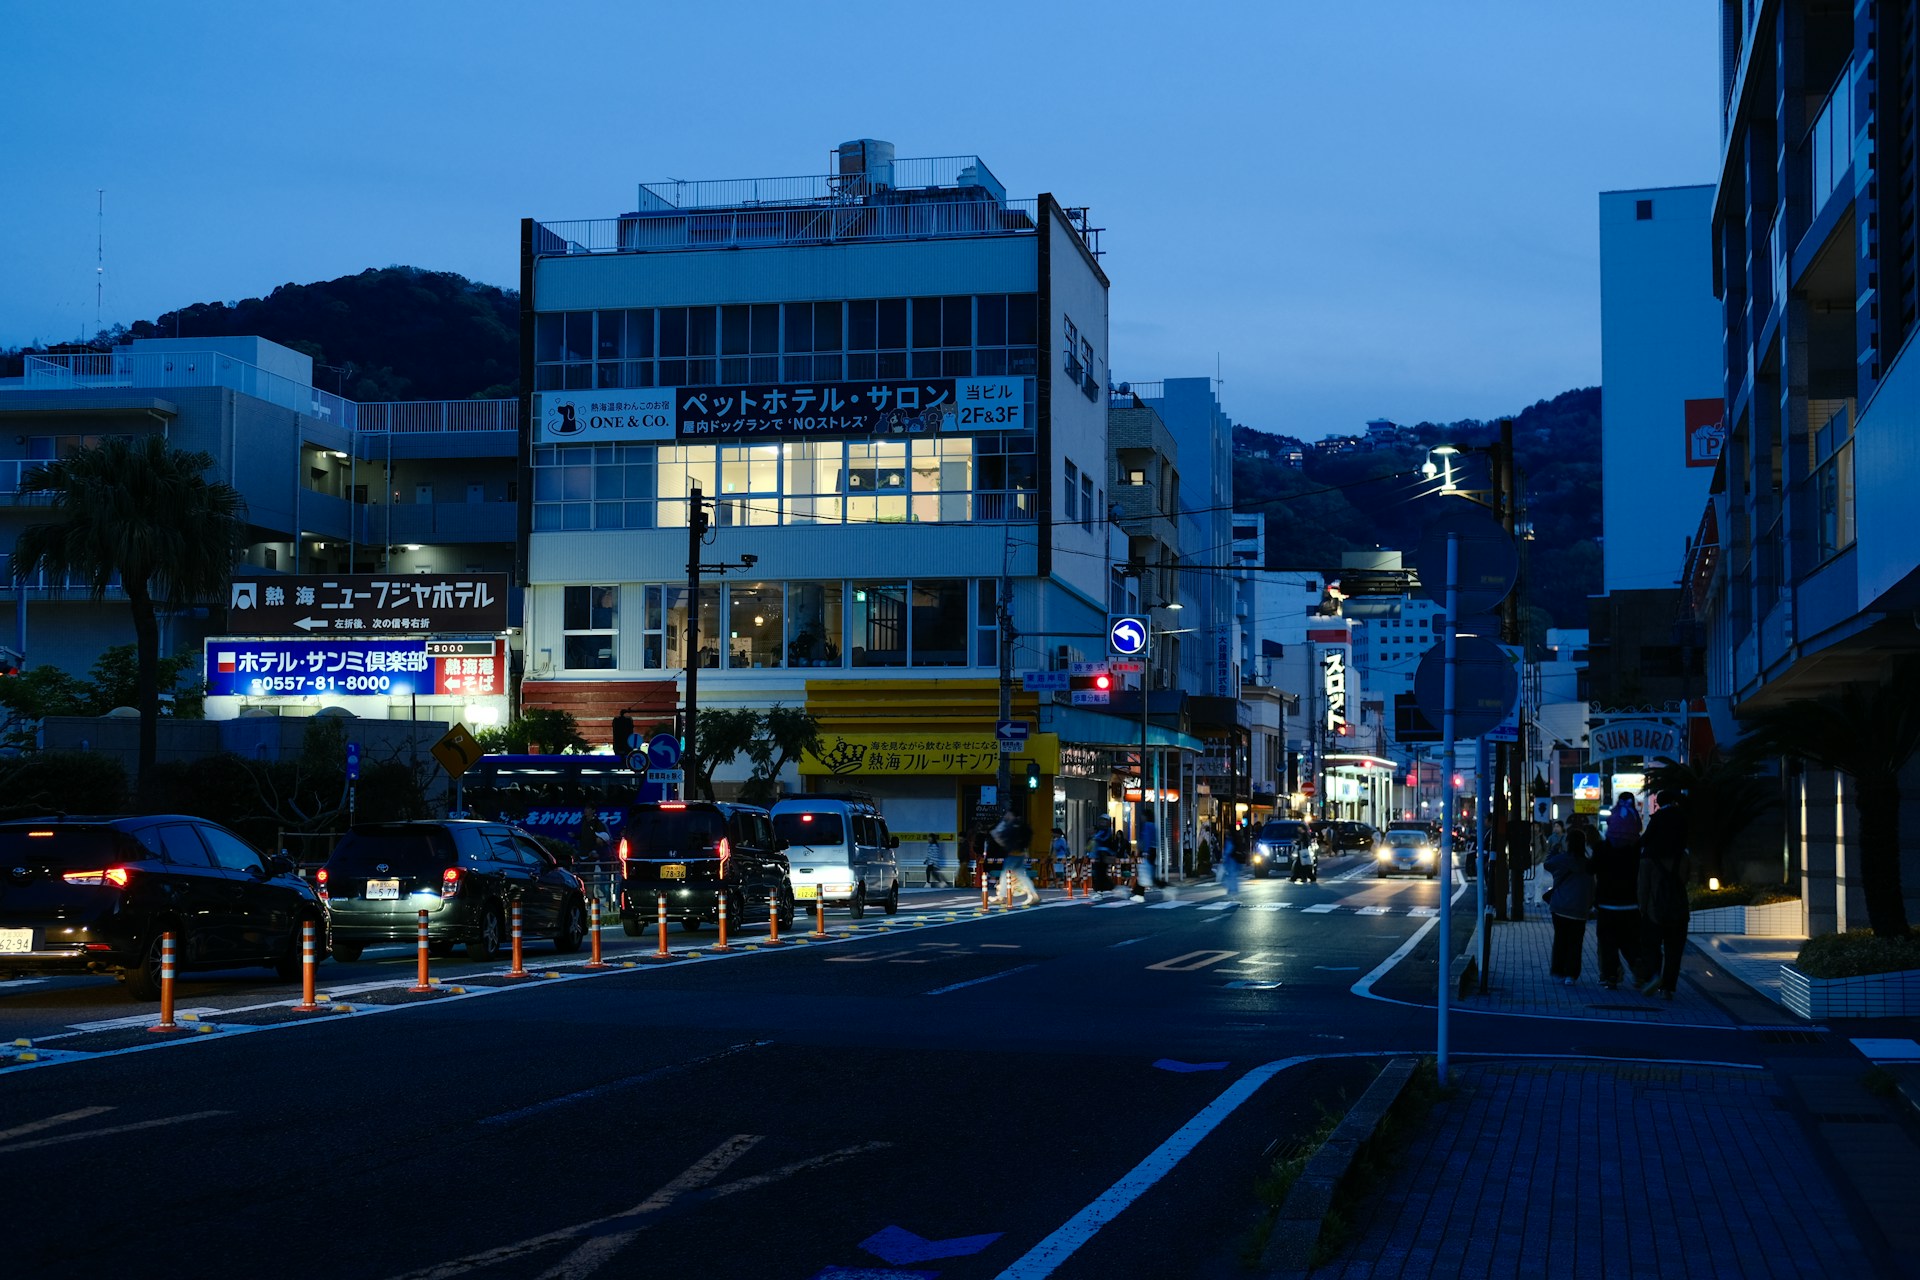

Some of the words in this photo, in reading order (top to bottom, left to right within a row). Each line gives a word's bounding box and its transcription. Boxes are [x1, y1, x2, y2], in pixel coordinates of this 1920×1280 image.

[966, 384, 1013, 401] 当ビル
[590, 401, 670, 413] 熱海温泉わんこのお宿
[682, 385, 949, 418] ペットホテル・サロン
[590, 415, 624, 429] ONE
[627, 415, 640, 428] &
[960, 406, 1019, 424] 2F&3F
[682, 418, 784, 434] 屋内ドッグランで
[265, 586, 315, 606] 熱海
[321, 582, 495, 609] ニューフジヤホテル
[334, 618, 430, 629] 左折後、次の信号右折
[238, 651, 429, 673] ホテル・サンミ倶楽部
[445, 657, 495, 675] 熱海港
[262, 676, 390, 690] 0557-81-8000
[462, 675, 495, 691] そば
[1326, 653, 1346, 731] スロット
[870, 741, 998, 751] 海を見ながら飲むと幸せになる
[1595, 728, 1629, 753] SUN
[1633, 728, 1674, 752] BIRD
[868, 752, 998, 771] 熱海フルーツキング
